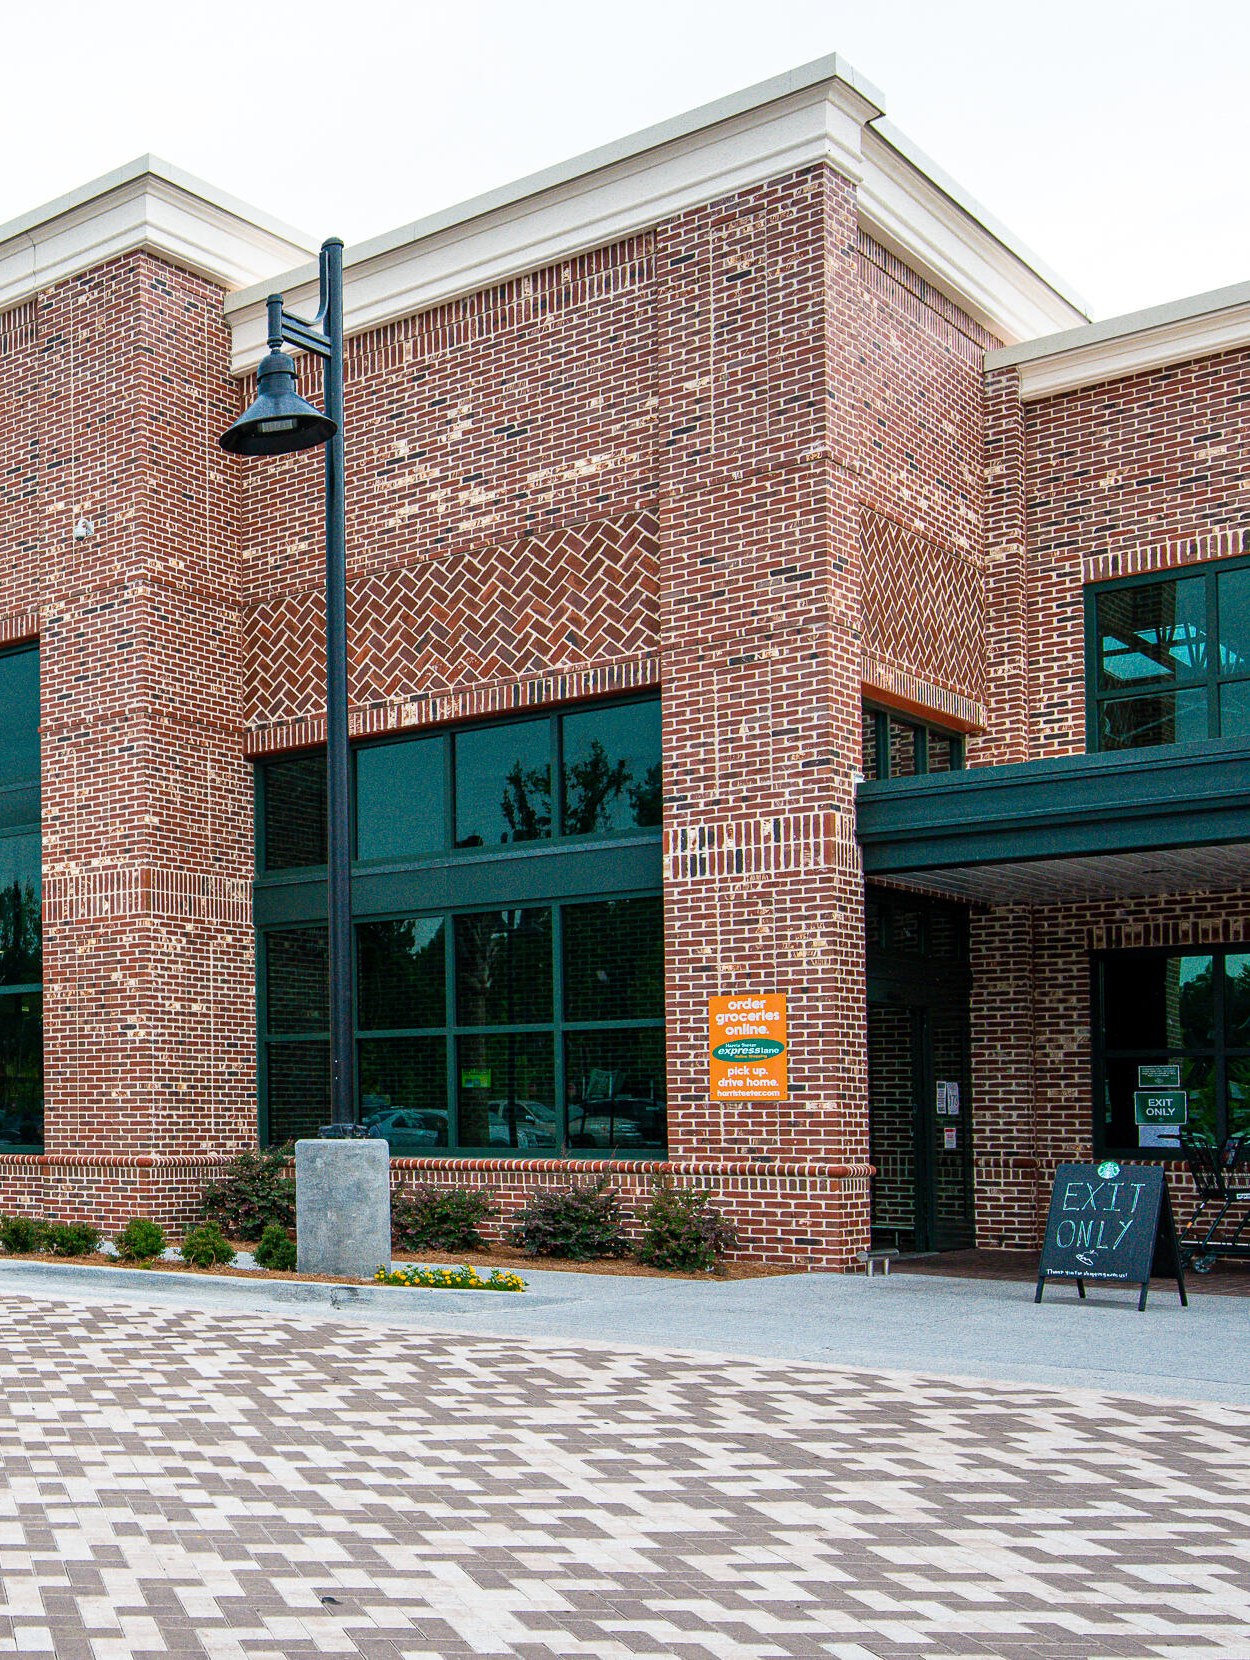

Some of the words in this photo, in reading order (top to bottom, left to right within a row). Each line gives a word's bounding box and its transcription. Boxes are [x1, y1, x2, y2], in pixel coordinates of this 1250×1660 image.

[727, 997, 767, 1011] order
[715, 1009, 781, 1026] groceries
[725, 1023, 770, 1036] online.
[727, 1065, 750, 1078] pick
[752, 1067, 769, 1078] up.
[717, 1077, 744, 1087] drive
[746, 1077, 779, 1087] home.
[716, 1089, 781, 1097] harristeeter.com
[1148, 1098, 1174, 1107] EXIT
[1145, 1107, 1176, 1116] ONLY
[1062, 1181, 1146, 1213] EXIT
[1056, 1219, 1134, 1250] ONLY
